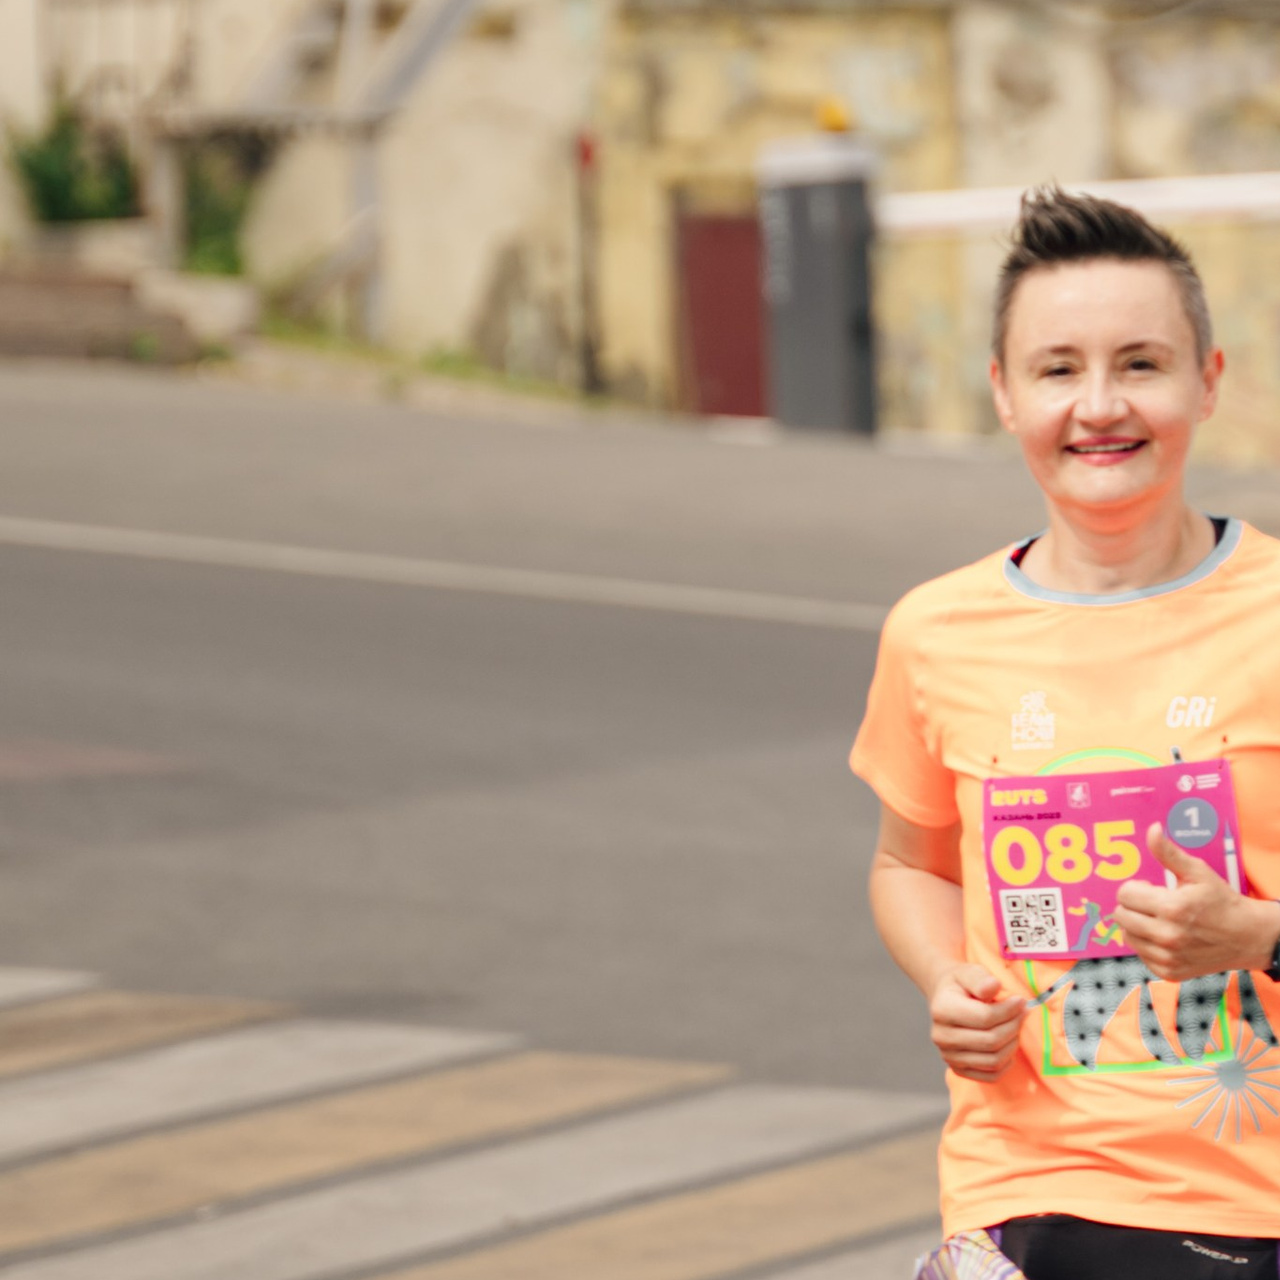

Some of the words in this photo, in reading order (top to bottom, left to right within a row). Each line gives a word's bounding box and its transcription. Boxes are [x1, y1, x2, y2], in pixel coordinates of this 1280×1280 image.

[1165, 695, 1217, 729] GRi
[1184, 806, 1200, 828] 1
[990, 819, 1142, 887] 085
